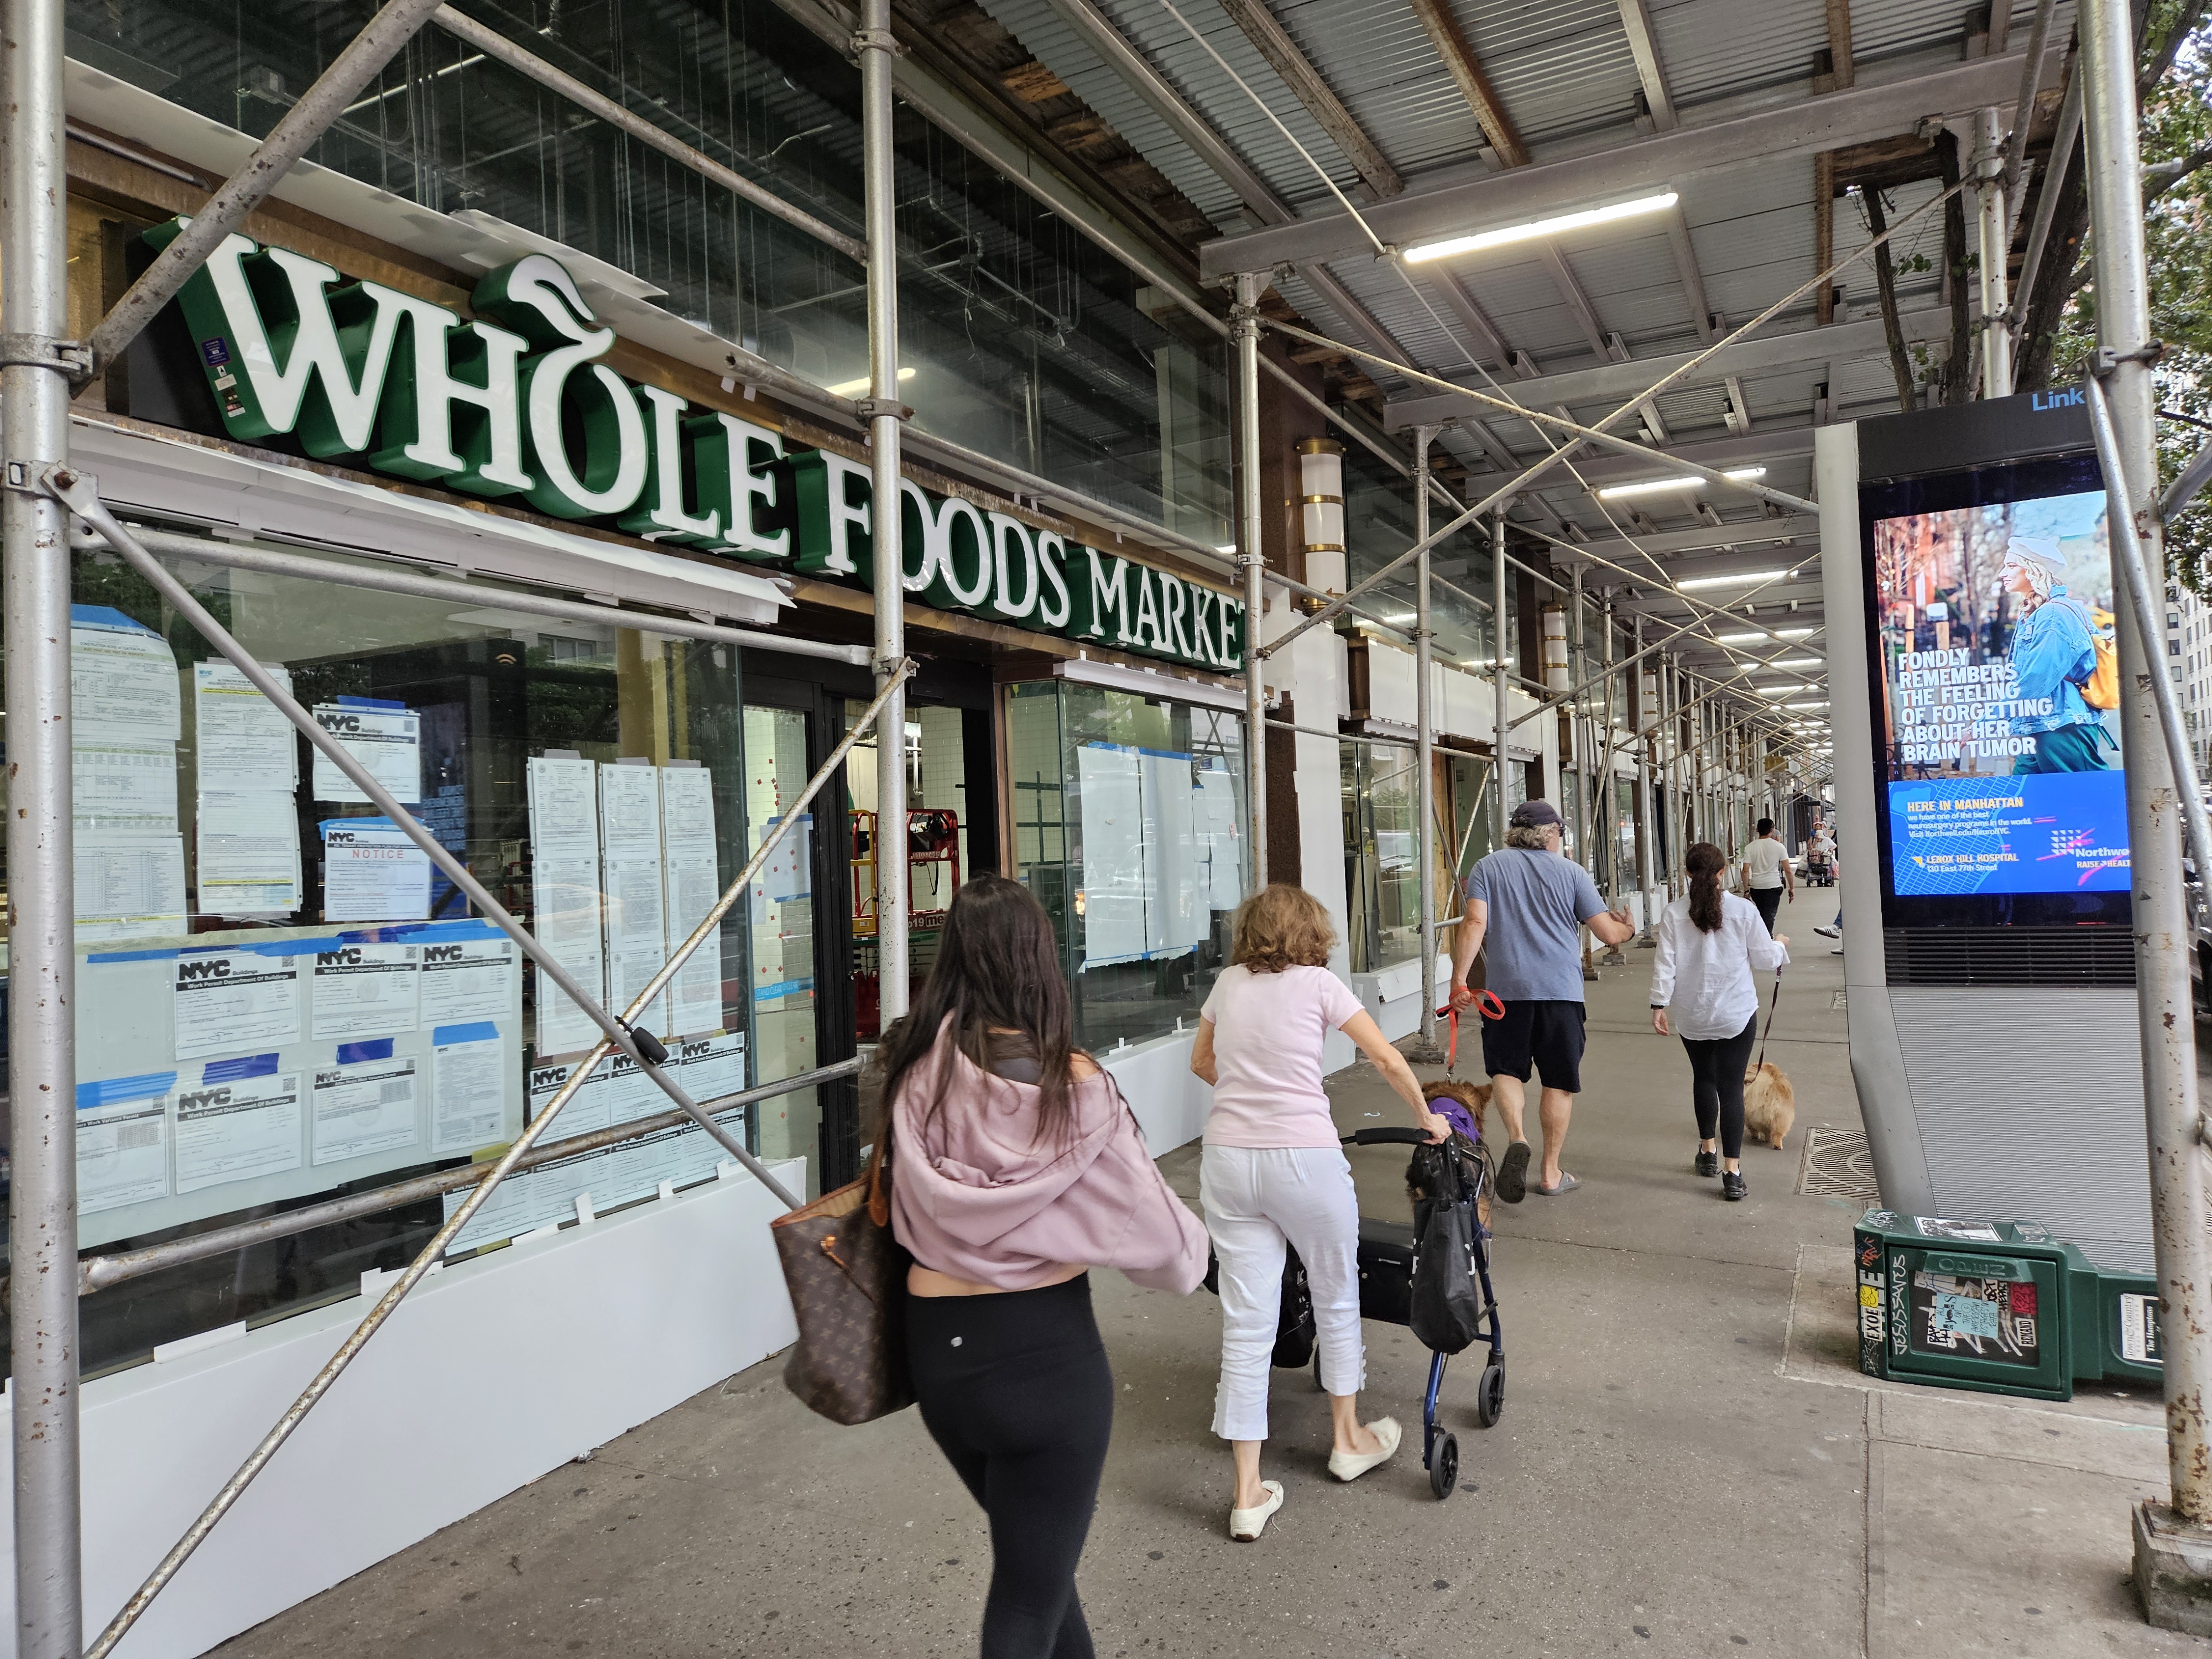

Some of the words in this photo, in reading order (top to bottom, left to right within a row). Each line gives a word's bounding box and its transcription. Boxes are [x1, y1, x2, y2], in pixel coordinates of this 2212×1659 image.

[2032, 388, 2085, 411] Link
[177, 215, 791, 557] WHOLE
[818, 448, 1071, 628] FOODS
[1084, 546, 1245, 670] MARKE
[1898, 647, 1969, 670] FONDLY
[1899, 662, 2018, 688] REMEMBERS
[1899, 688, 1935, 707] THE
[1942, 681, 2021, 704] FEELING
[1901, 707, 1926, 725] OF
[1932, 698, 2053, 723] FORGETTING
[317, 714, 360, 732] NYC
[1902, 723, 1965, 744] ABOUT
[1971, 720, 2010, 739] HER
[1903, 742, 1960, 761] BRAIN
[1966, 737, 2036, 758] TUMOR
[1907, 800, 1936, 812] HERE
[1939, 800, 1951, 811] IN
[1954, 797, 2024, 810] MANHATTAN
[1908, 822, 1954, 831] neurosurgery
[1955, 821, 1989, 829] programs
[328, 832, 354, 842] NYC
[352, 849, 404, 858] NOTICE
[1927, 855, 1953, 864] LENOX
[1957, 854, 1975, 863] HILL
[1977, 853, 2020, 862] HOSPITAL
[2075, 847, 2130, 857] Northwe
[1976, 863, 1998, 872] Street
[317, 948, 361, 965] NYC
[424, 945, 462, 962] NYC
[179, 959, 230, 981] NYC
[224, 977, 256, 985] Department
[682, 1041, 709, 1058] NYC
[613, 1054, 637, 1070] NY
[316, 1071, 341, 1083] NYC
[534, 1067, 567, 1087] NYC
[179, 1087, 231, 1111] NYC
[224, 1104, 257, 1113] Department
[1939, 1258, 2006, 1276] OPEN
[1937, 1306, 1945, 1316] ALL
[1954, 1310, 1961, 1318] ON
[1963, 1314, 1971, 1324] THE
[1971, 1301, 1980, 1332] AMERICAN
[2124, 1295, 2135, 1327] Country
[1980, 1307, 1990, 1336] HOSTAGES
[2146, 1306, 2156, 1339] Hamptons
[2019, 1321, 2034, 1345] REMAND
[2125, 1337, 2133, 1357] Town
[2146, 1339, 2155, 1352] The
